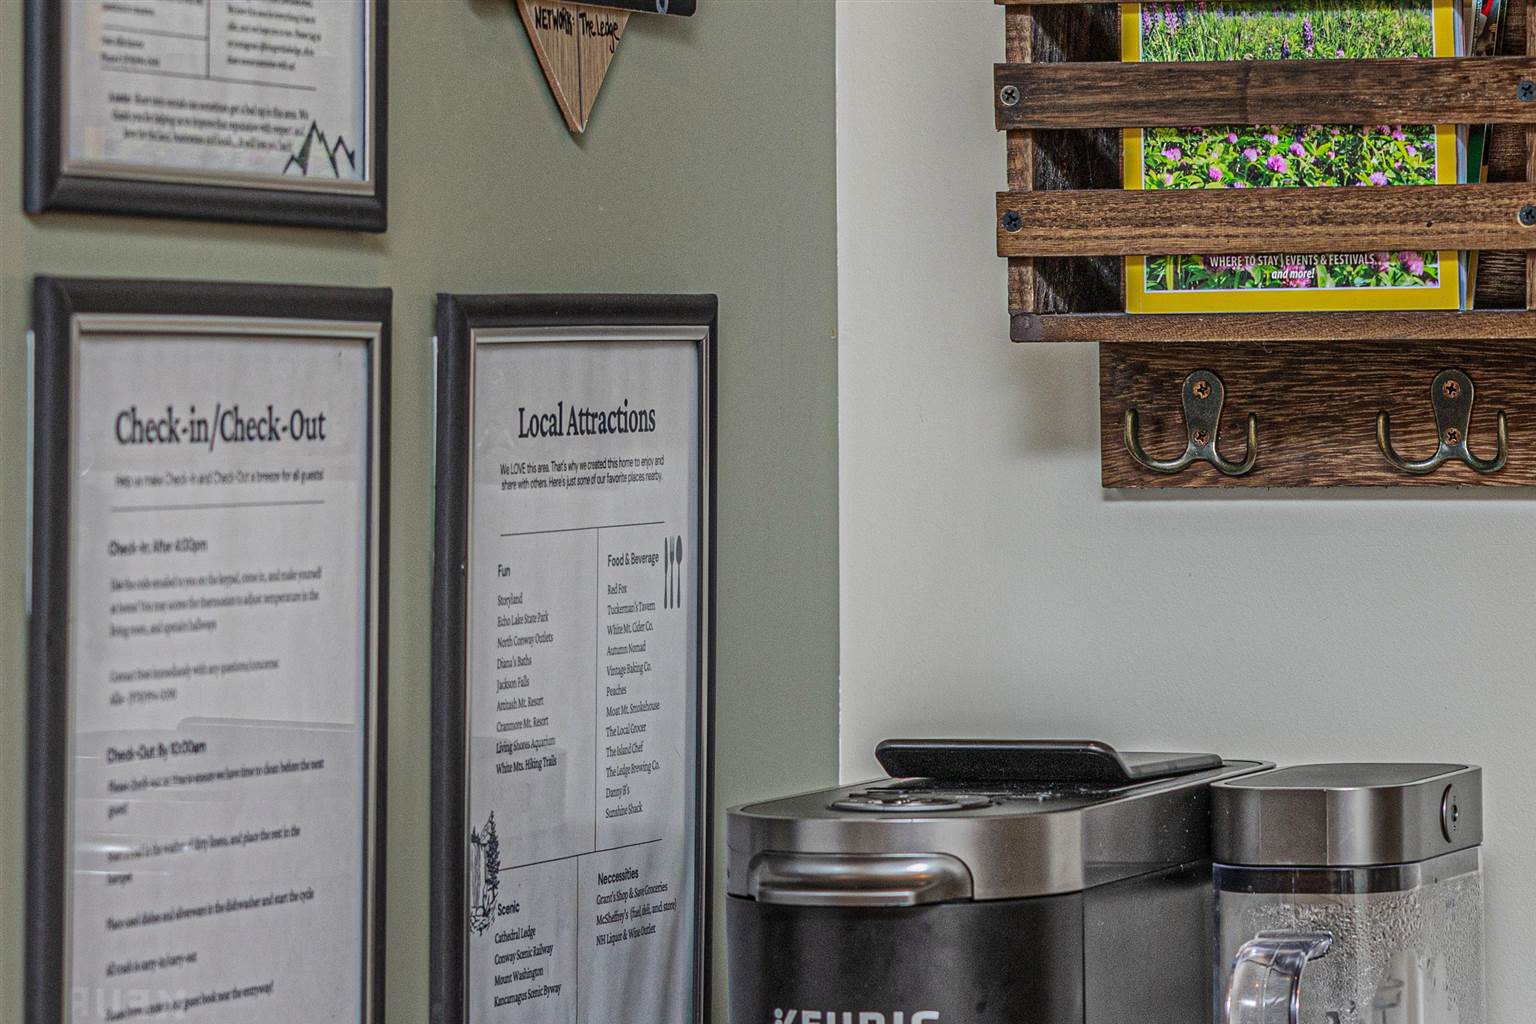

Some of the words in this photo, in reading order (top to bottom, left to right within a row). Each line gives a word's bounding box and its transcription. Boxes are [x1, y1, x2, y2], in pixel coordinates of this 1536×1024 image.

[579, 12, 596, 39] The
[595, 13, 620, 54] Ledge
[1209, 255, 1242, 268] WHERE
[1244, 254, 1256, 267] TO
[1257, 254, 1280, 266] STAY
[1285, 254, 1318, 266] EVENTS
[1319, 254, 1328, 265] &
[1271, 268, 1287, 280] and
[1288, 266, 1316, 280] more!
[518, 400, 565, 438] Local
[566, 398, 657, 436] Attractions
[115, 402, 328, 452] Check-in/Check-Out
[500, 463, 510, 475] We
[510, 462, 526, 475] LOVE
[527, 461, 537, 473] this
[568, 460, 579, 473] why
[588, 458, 607, 470] created
[607, 457, 619, 469] this
[619, 457, 633, 469] home
[641, 456, 655, 470] enjoy
[655, 455, 665, 467] and
[501, 480, 517, 490] share
[518, 478, 530, 489] with
[577, 475, 591, 486] some
[607, 471, 628, 483] favorite
[607, 552, 625, 567] Food
[625, 552, 631, 566] &
[631, 552, 660, 567] Beverage
[497, 564, 511, 577] Fun
[511, 613, 524, 626] Lake
[537, 609, 549, 622] Park
[497, 635, 513, 648] North
[513, 635, 534, 648] Conway
[495, 677, 517, 694] Jackson
[517, 674, 530, 688] Falls
[606, 684, 628, 696] Peaches
[533, 716, 550, 727] Resort
[606, 725, 616, 737] The
[616, 722, 630, 736] Local
[630, 722, 647, 734] Grocer
[496, 740, 513, 755] Living
[606, 745, 616, 758] The
[496, 761, 513, 774] White
[525, 757, 543, 772] Hiking
[542, 754, 558, 768] Trails
[606, 765, 616, 778] The
[616, 763, 631, 778] Ledge
[630, 761, 651, 775] Brewing
[605, 804, 628, 818] Sunshine
[628, 800, 644, 815] Shack
[597, 867, 640, 886] Neccessities
[596, 890, 616, 905] Grant's
[616, 889, 629, 903] Shop
[634, 885, 646, 898] Save
[645, 881, 669, 895] Groceries
[497, 900, 520, 916] Scenic
[494, 927, 521, 944] Cathedral
[521, 925, 537, 940] Ledge
[596, 934, 606, 946] NH
[494, 953, 516, 965] Conway
[516, 946, 533, 961] Scenic
[532, 943, 554, 957] Railway
[494, 974, 513, 986] Mount
[512, 967, 545, 981] Washington
[527, 986, 544, 1000] Scenic
[543, 983, 562, 998] Byway
